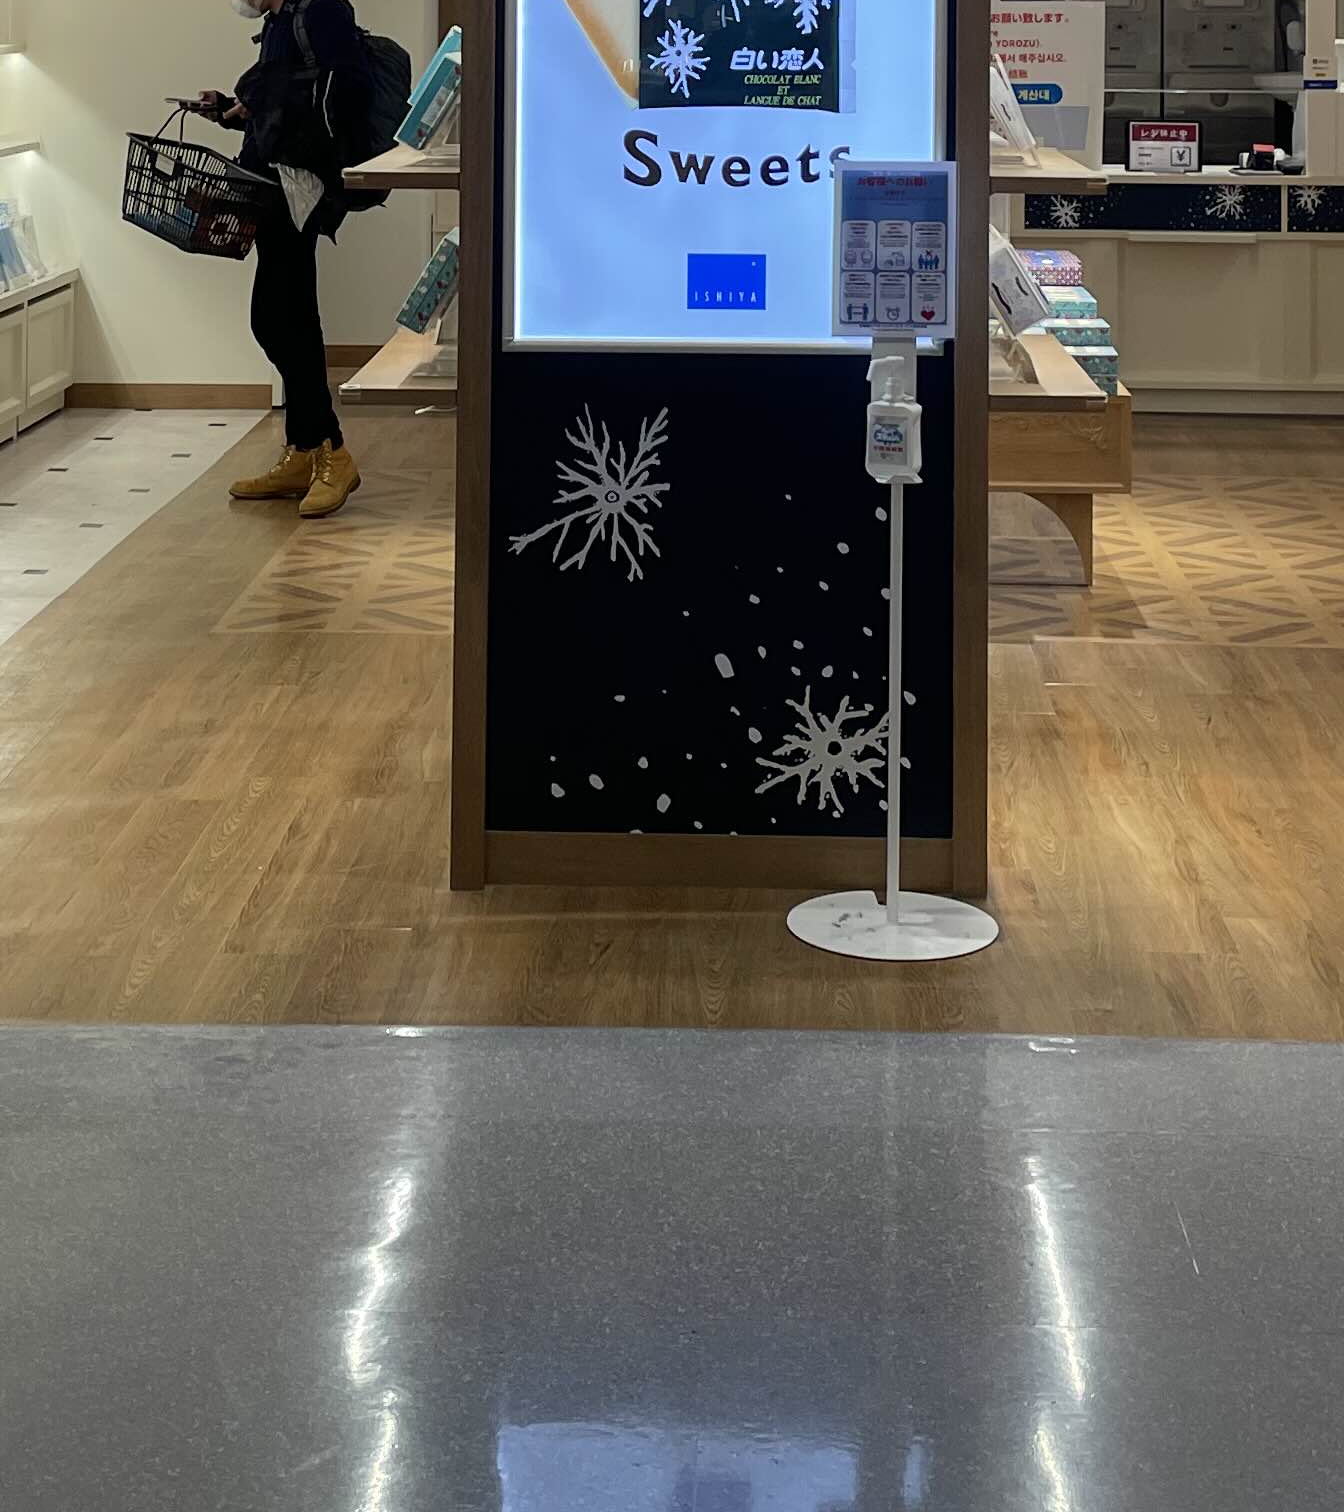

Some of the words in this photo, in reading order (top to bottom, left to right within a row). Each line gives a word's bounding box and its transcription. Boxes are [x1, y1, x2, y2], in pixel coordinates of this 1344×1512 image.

[730, 46, 824, 71] 白い恋人
[744, 74, 792, 85] CHOCOLAT
[793, 74, 822, 85] BLANC
[777, 85, 790, 95] ET
[744, 95, 781, 106] LANGUE
[782, 96, 795, 106] DE
[797, 96, 822, 106] CHAT
[694, 291, 757, 303] ISHIYA
